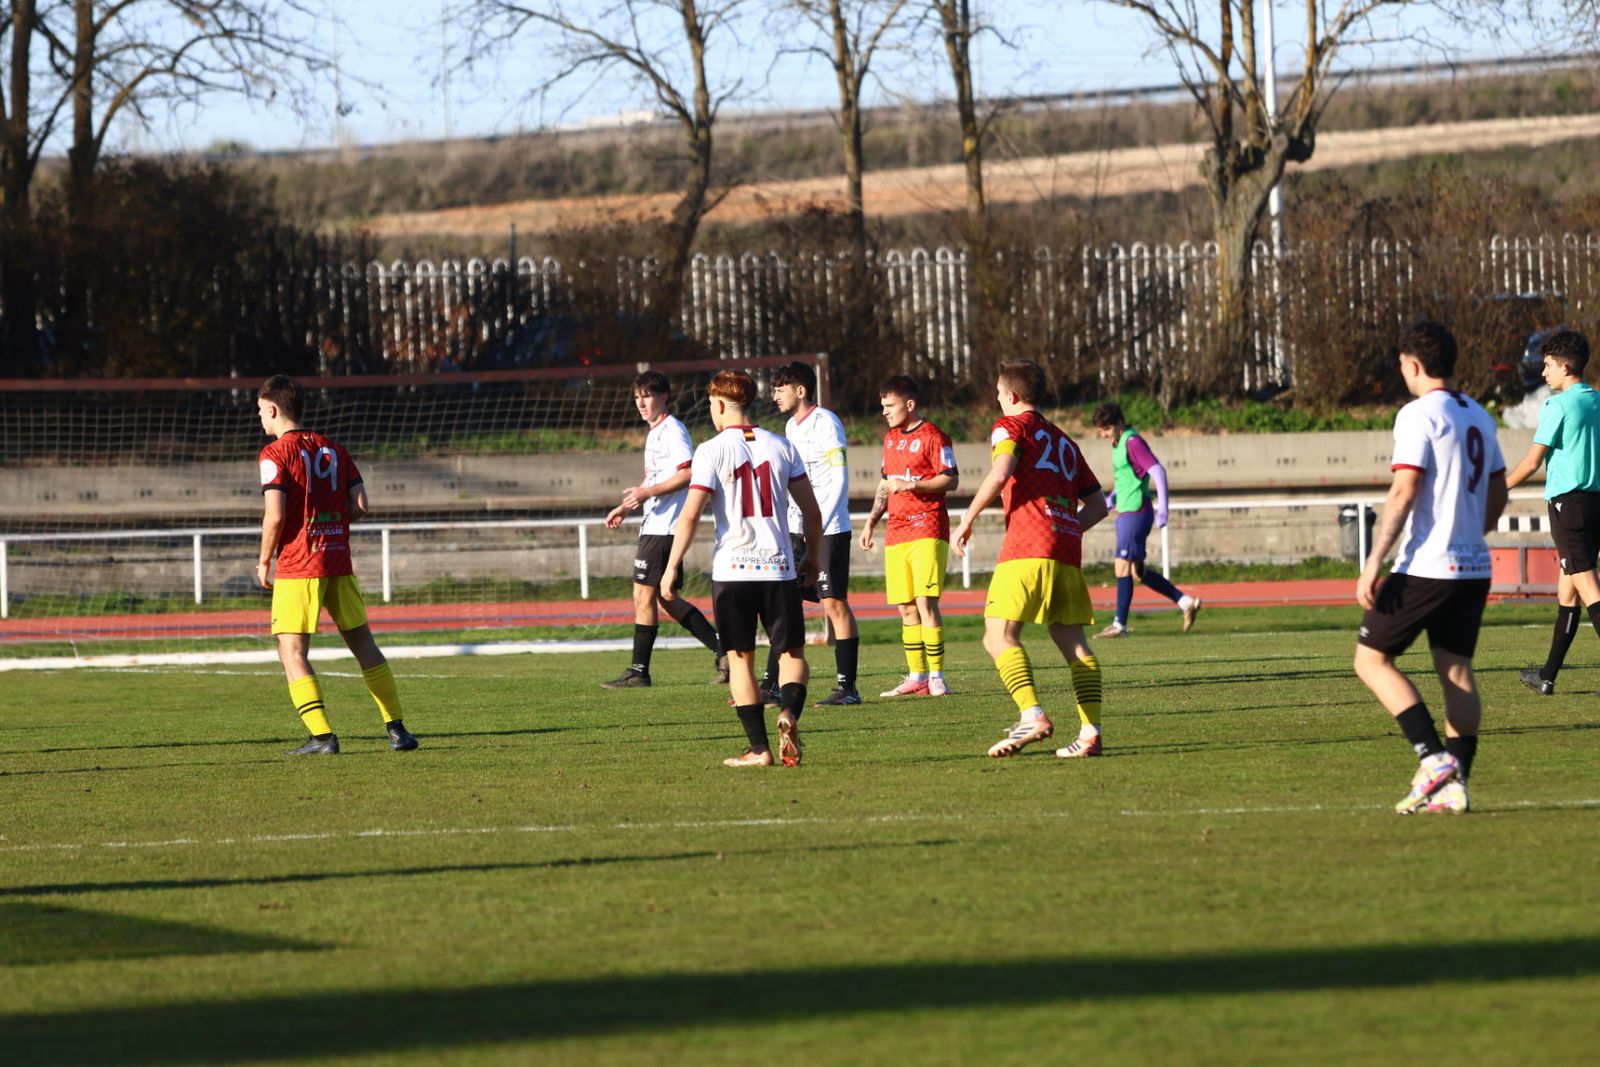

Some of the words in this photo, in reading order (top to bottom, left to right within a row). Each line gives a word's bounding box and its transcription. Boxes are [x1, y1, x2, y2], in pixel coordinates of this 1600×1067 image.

[301, 446, 338, 493] 19
[1034, 429, 1077, 481] 20
[1466, 426, 1484, 494] 9
[733, 460, 773, 517] 11
